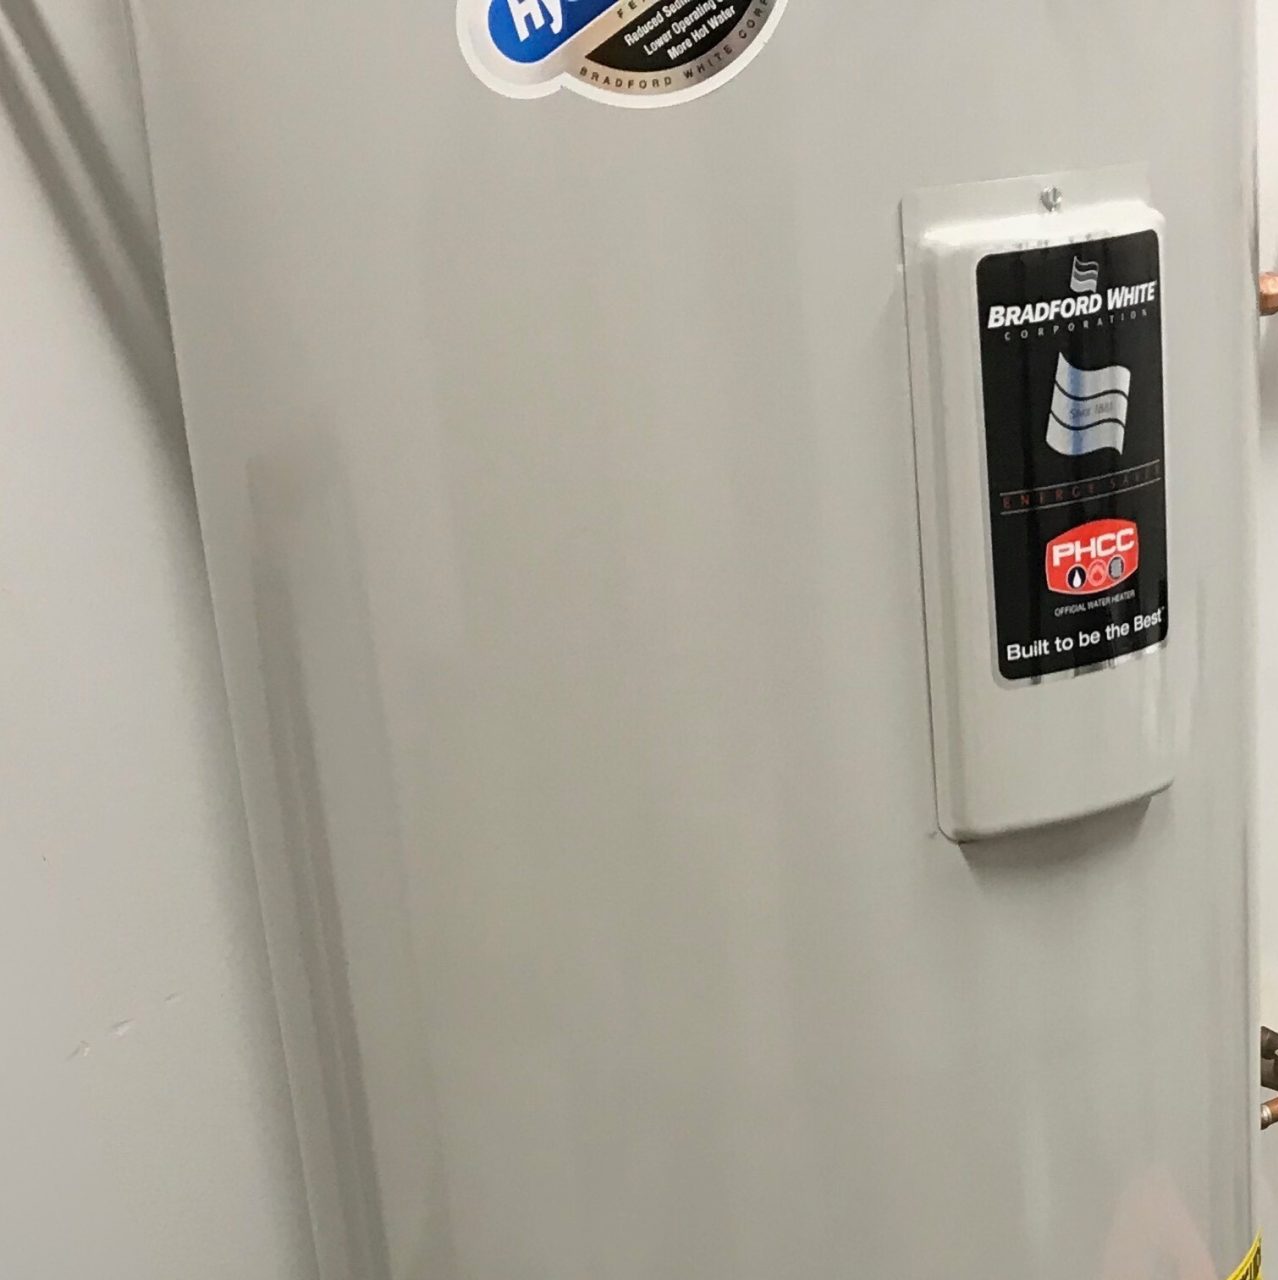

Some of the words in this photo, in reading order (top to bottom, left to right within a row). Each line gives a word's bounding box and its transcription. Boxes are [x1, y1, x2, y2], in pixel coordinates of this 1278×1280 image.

[507, 0, 577, 42] Hy
[624, 11, 664, 46] Reduced
[644, 30, 672, 56] Lower
[672, 0, 717, 34] Operating
[667, 38, 692, 60] More
[690, 24, 709, 43] Hot
[707, 6, 735, 30] Water
[579, 67, 673, 89] BRADFORD
[683, 44, 733, 79] WHITE
[988, 293, 1102, 329] BRADFORD
[1106, 280, 1157, 310] WHITE
[1004, 309, 1147, 341] CORPORATION
[1052, 528, 1134, 566] PHCC
[1054, 602, 1086, 617] OFFICIAL
[1087, 597, 1110, 610] WATER
[1112, 590, 1136, 603] HEATER
[1006, 639, 1050, 661] Built
[1054, 636, 1074, 652] to
[1079, 630, 1100, 647] be
[1106, 622, 1130, 640] the
[1134, 608, 1163, 632] Best
